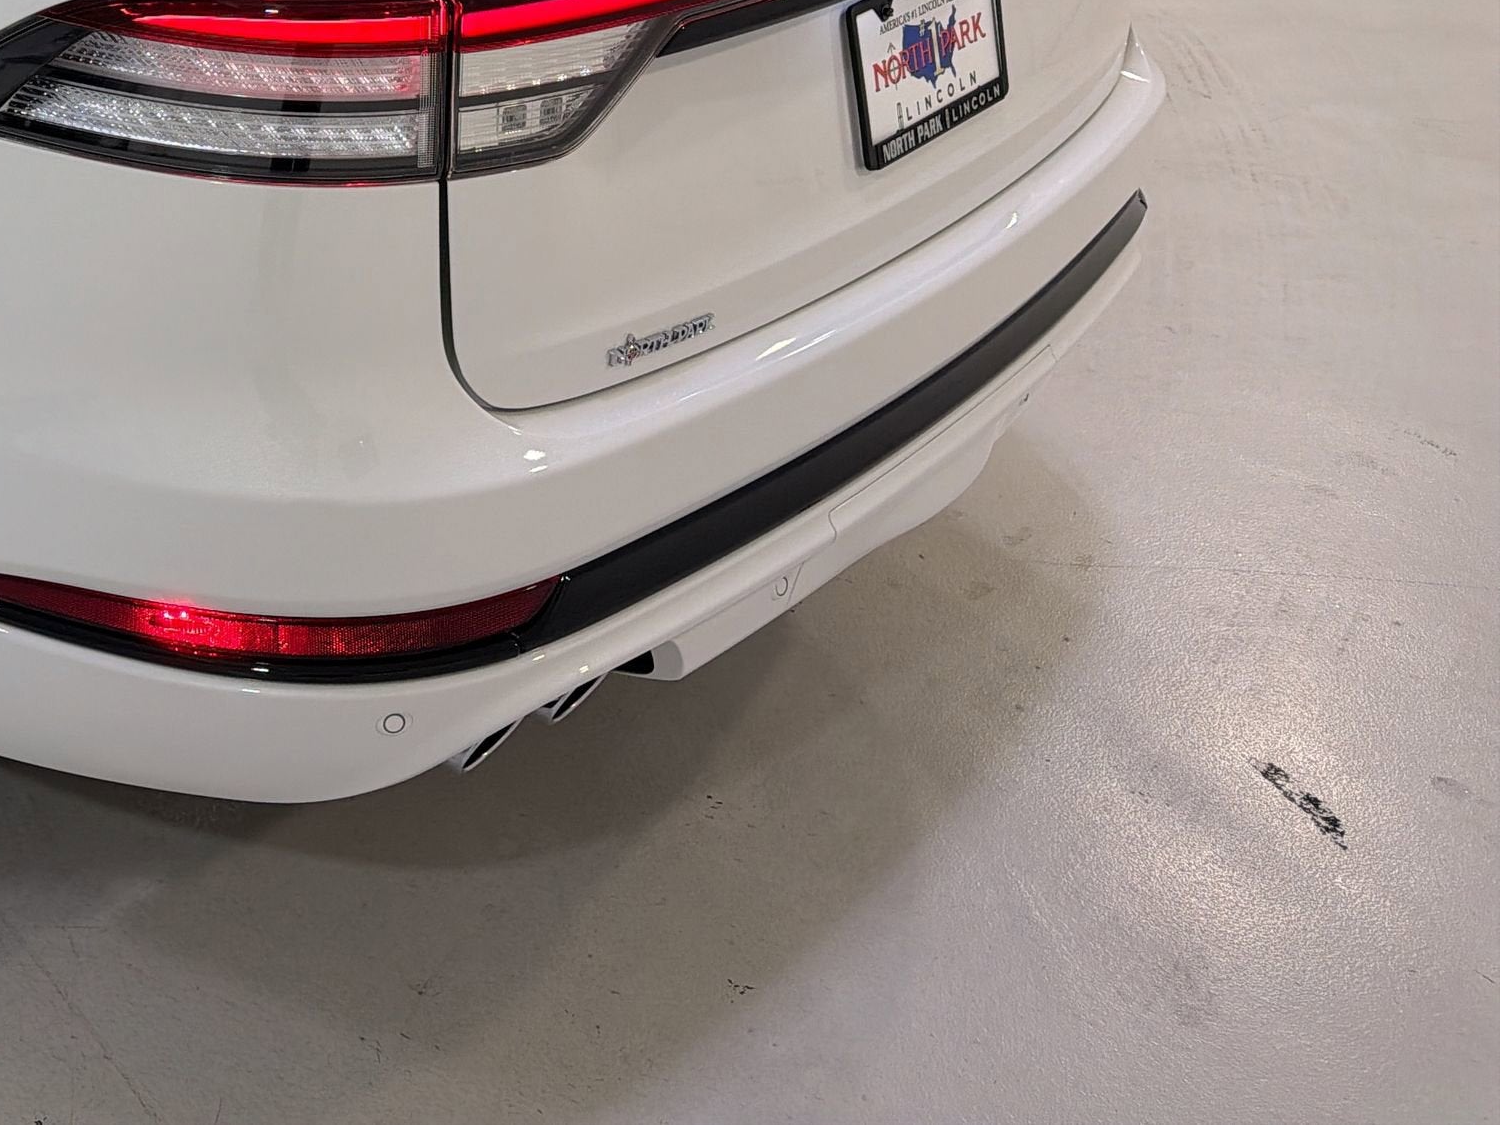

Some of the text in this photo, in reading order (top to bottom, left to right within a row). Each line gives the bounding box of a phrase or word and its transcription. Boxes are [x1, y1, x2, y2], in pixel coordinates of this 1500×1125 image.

[872, 12, 987, 93] NORTH PARK
[879, 11, 911, 35] AMERICA'S
[882, 84, 1001, 163] NORTH PARK LINCOLN
[906, 71, 977, 121] LINCOLN
